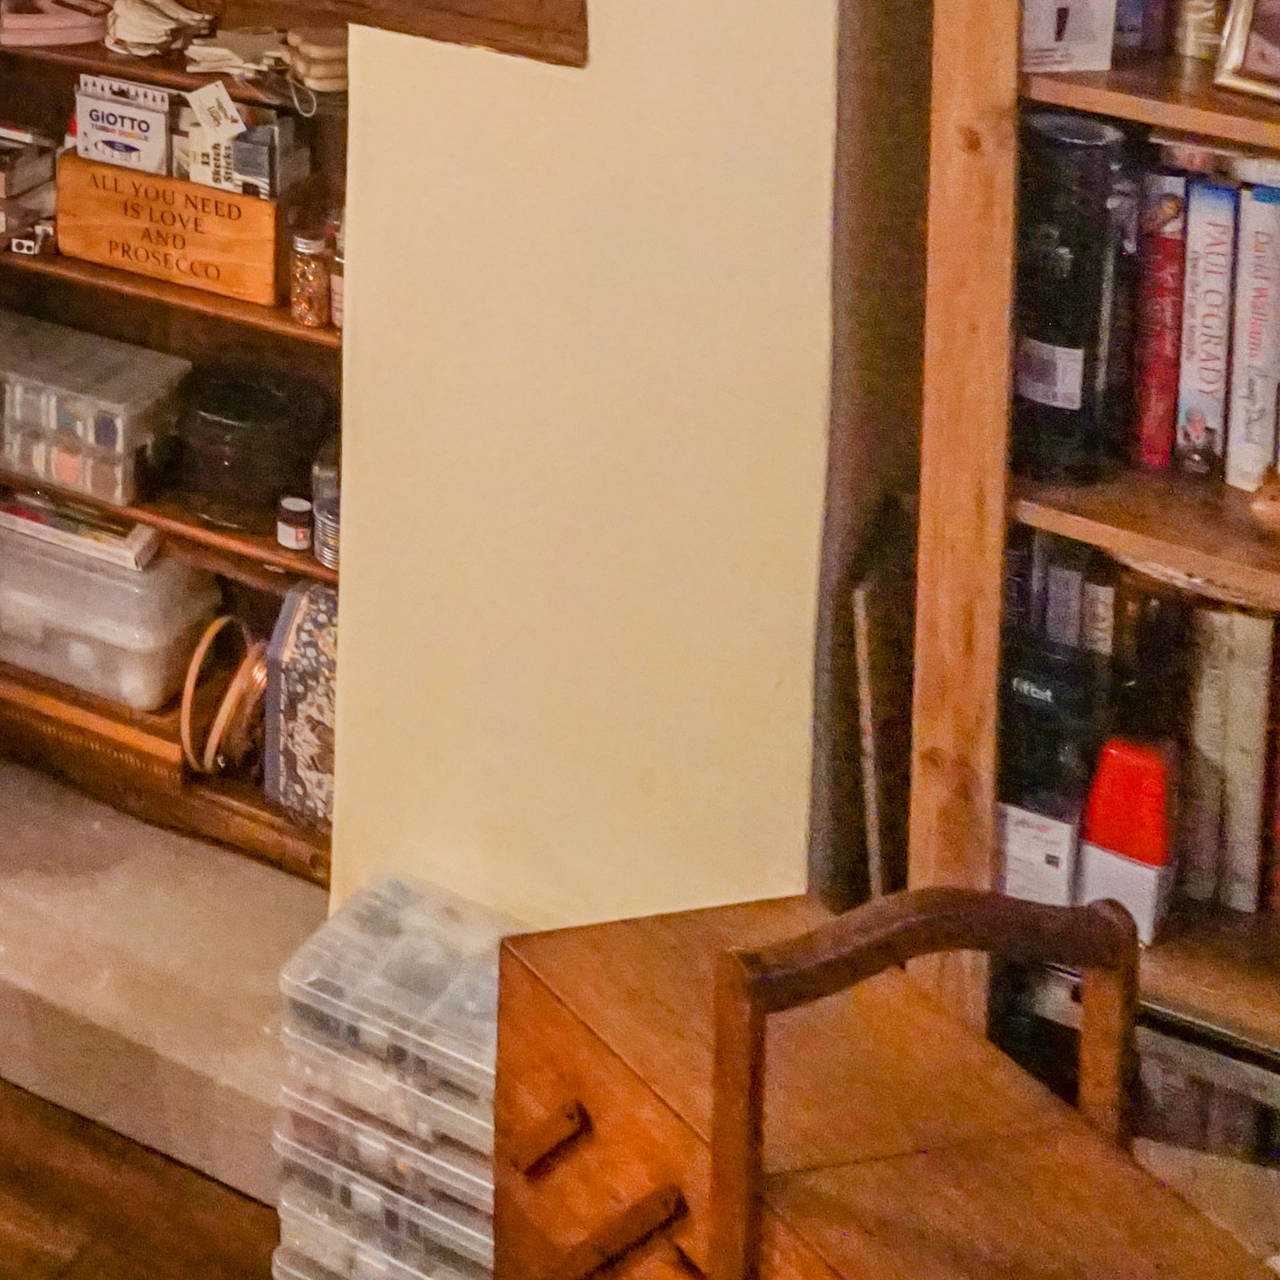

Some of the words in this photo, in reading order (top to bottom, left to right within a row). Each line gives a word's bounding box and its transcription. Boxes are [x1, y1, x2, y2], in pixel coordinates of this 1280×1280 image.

[89, 108, 150, 133] GIOTTO
[201, 150, 211, 167] 12
[211, 142, 223, 183] Sketch
[223, 144, 235, 183] Sticks
[89, 173, 123, 192] ALL
[131, 181, 176, 205] YOU
[184, 194, 243, 221] NEED
[123, 200, 142, 220] IS
[148, 207, 206, 234] LOVE
[140, 228, 187, 250] AND
[1204, 220, 1230, 275] PAUL
[108, 240, 222, 281] PROSECCO
